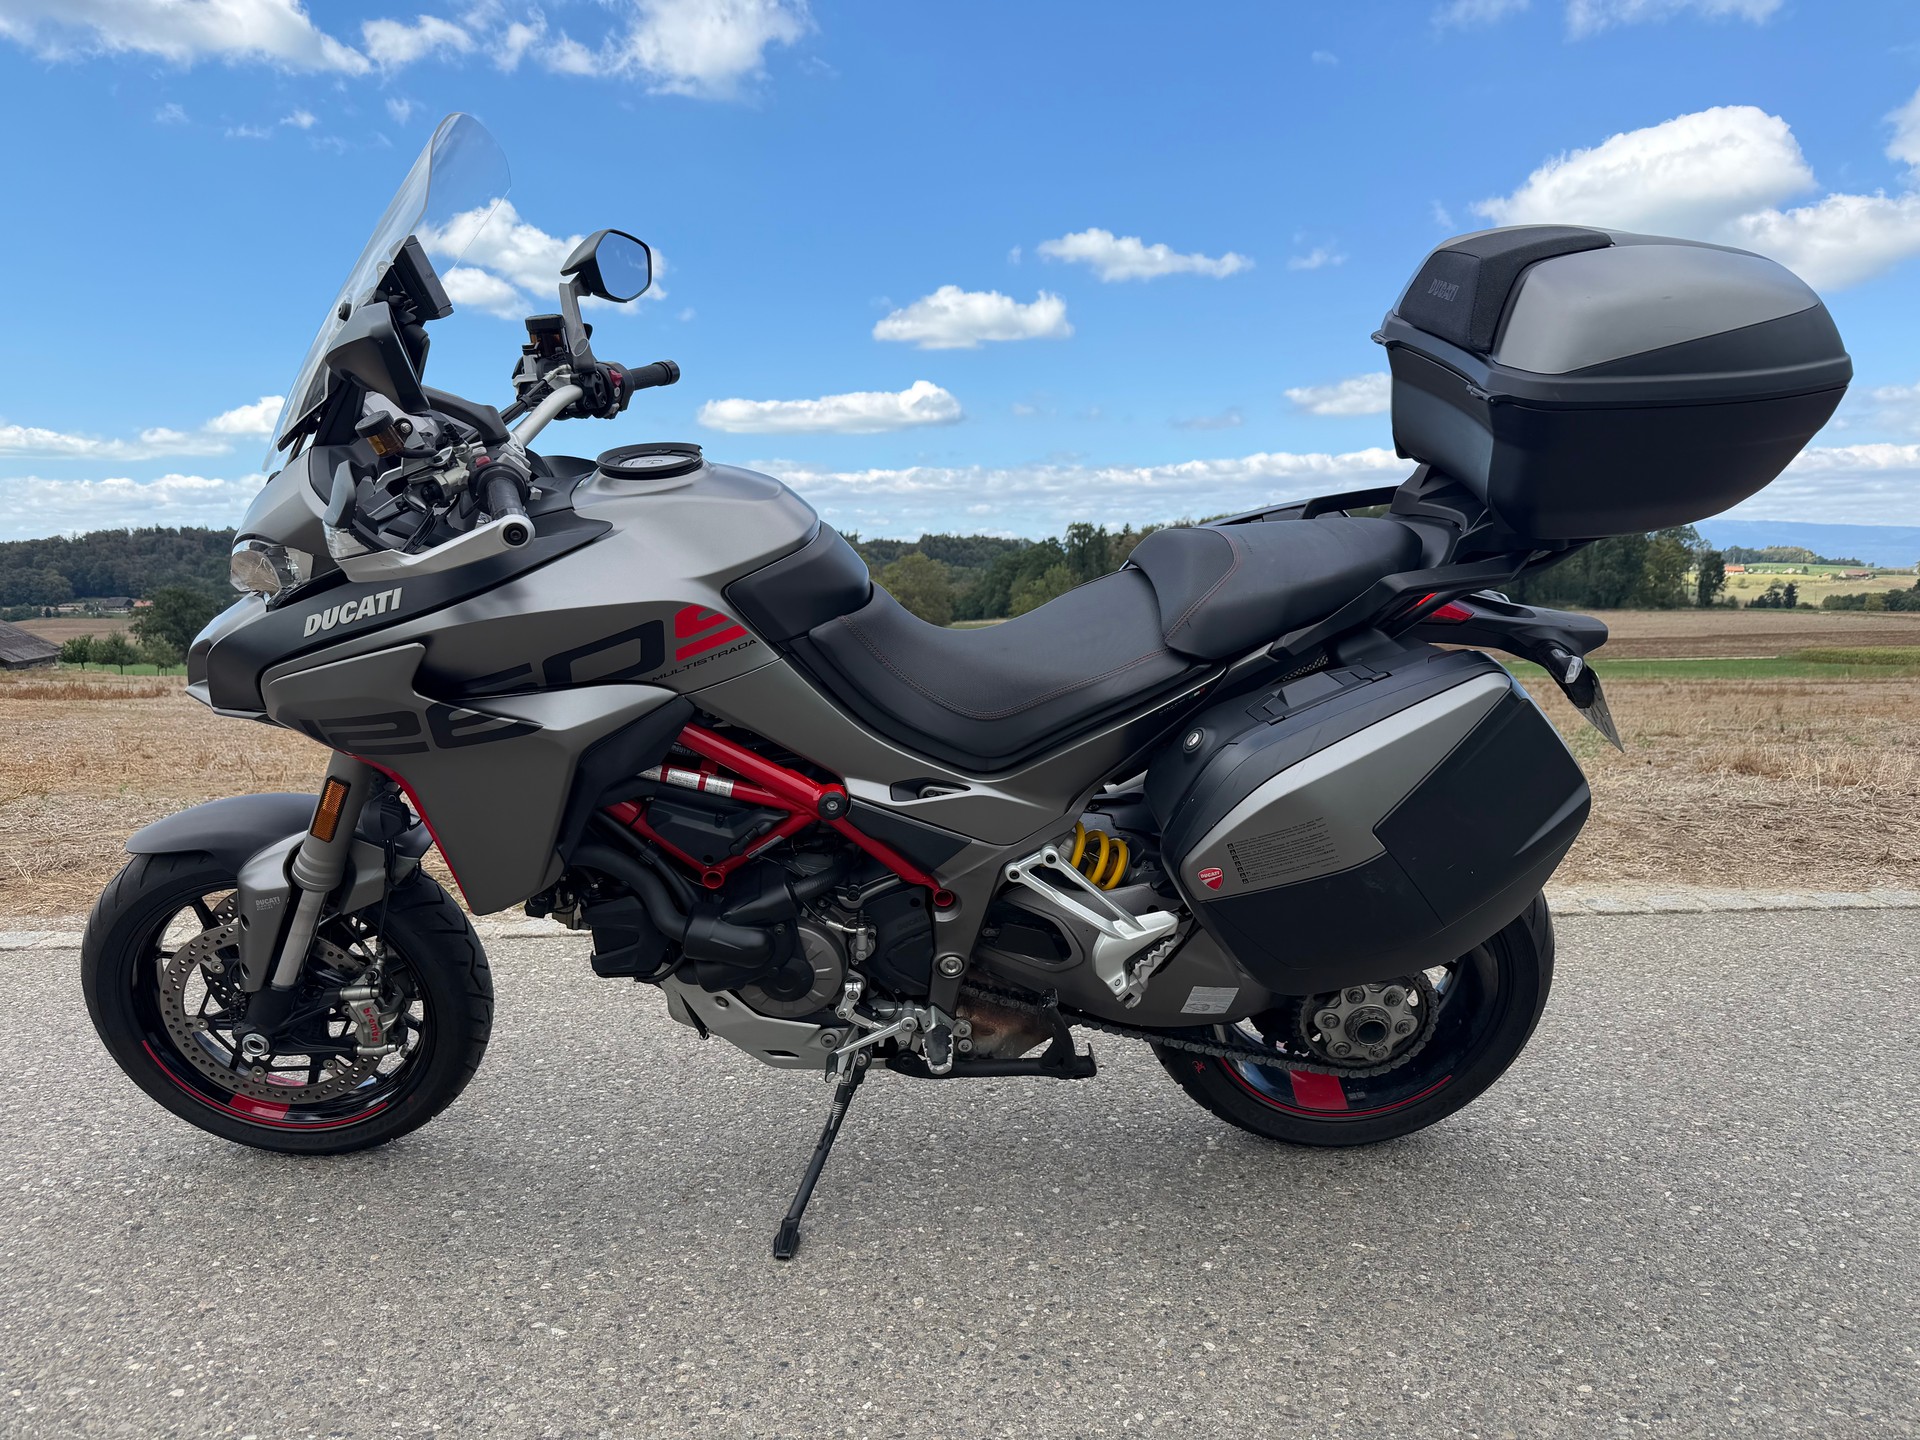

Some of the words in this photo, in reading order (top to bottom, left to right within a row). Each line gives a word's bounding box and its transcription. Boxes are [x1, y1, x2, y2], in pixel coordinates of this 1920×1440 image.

[1428, 278, 1459, 302] DUCATI
[303, 587, 403, 638] DUCATI
[652, 639, 757, 681] MULTISTRADA
[1200, 870, 1221, 879] DUCATI
[255, 896, 281, 906] DUCATI
